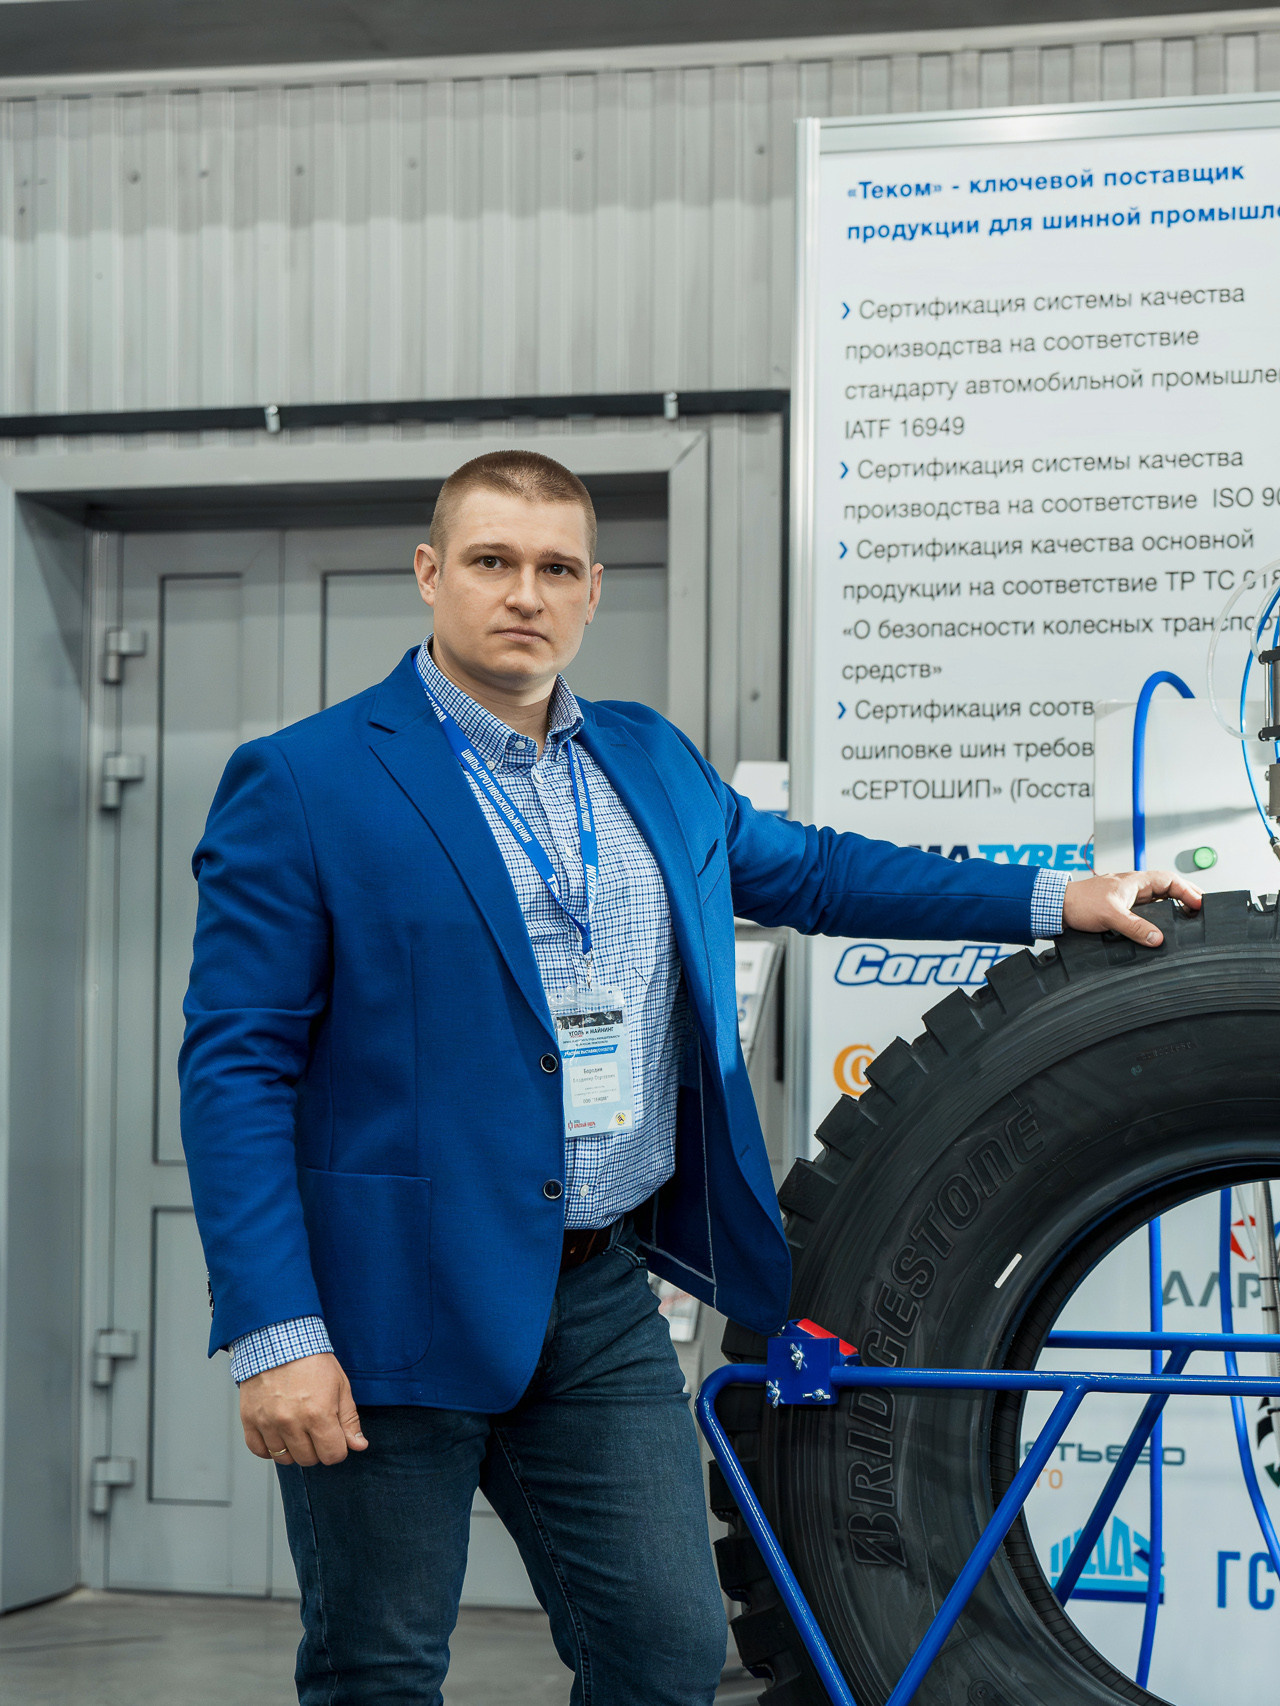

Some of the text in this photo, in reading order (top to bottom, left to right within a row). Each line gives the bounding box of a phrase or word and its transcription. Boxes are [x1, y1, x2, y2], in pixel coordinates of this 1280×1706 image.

[847, 180, 942, 200] «Теком»
[969, 167, 1095, 194] ключевой
[1103, 164, 1245, 188] поставщик
[847, 219, 980, 244] продукции
[988, 216, 1033, 237] для
[1042, 206, 1141, 230] шинной
[858, 286, 1245, 323] Сертификация системы качества
[845, 328, 1200, 364] производства на соответствие
[844, 380, 957, 406] стандарту
[965, 368, 1144, 397] автомобильной
[845, 415, 966, 440] IATF 16949
[857, 449, 1244, 483] Сертификация системы качества
[843, 499, 1001, 524] производства
[1007, 497, 1035, 515] на
[1041, 491, 1198, 515] соответствие
[1213, 486, 1255, 509] ISO
[856, 528, 1254, 563] Сертификация качества основной
[843, 580, 962, 606] продукции
[969, 579, 996, 598] на
[1002, 574, 1158, 598] соответствие
[1164, 570, 1196, 592] ТР
[1202, 569, 1236, 591] ТС
[842, 618, 872, 641] «О
[877, 614, 1035, 641] безопасности
[1042, 615, 1154, 637] колесных
[841, 663, 943, 685] средств»
[854, 699, 1095, 724] Сертификация соотв
[840, 737, 1094, 763] ошиповке шин требов
[461, 748, 533, 844] ШИПЫ ПРОТИВОСКОЛЬЖЕНИЯ
[841, 777, 1094, 803] «СЕРТОШИП» (Госста
[834, 943, 1011, 986] Cordi
[847, 1105, 1047, 1568] BRIDGESTONE
